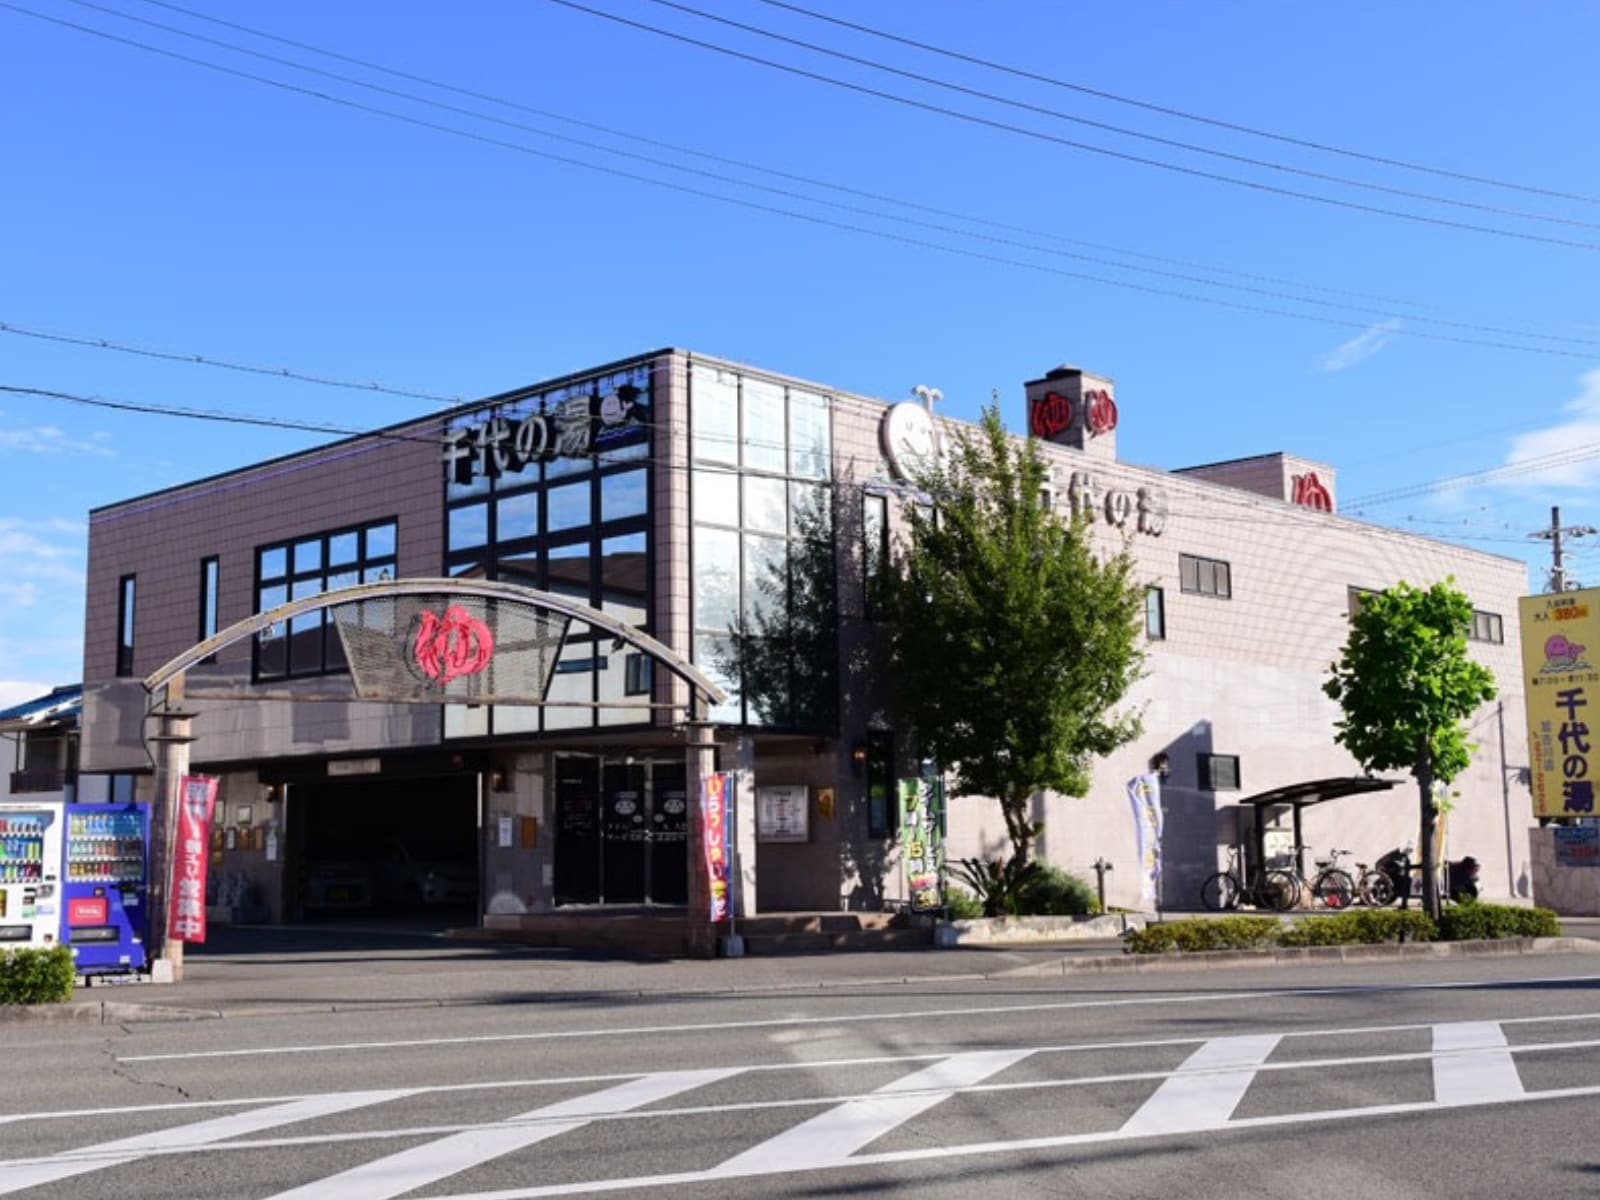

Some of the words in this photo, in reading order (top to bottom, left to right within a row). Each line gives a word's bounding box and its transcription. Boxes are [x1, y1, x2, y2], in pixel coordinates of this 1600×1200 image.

[442, 395, 591, 483] 千代の湯
[1030, 391, 1073, 439] ゆ
[414, 604, 495, 687] ゆ
[1556, 687, 1595, 813] 千代の湯
